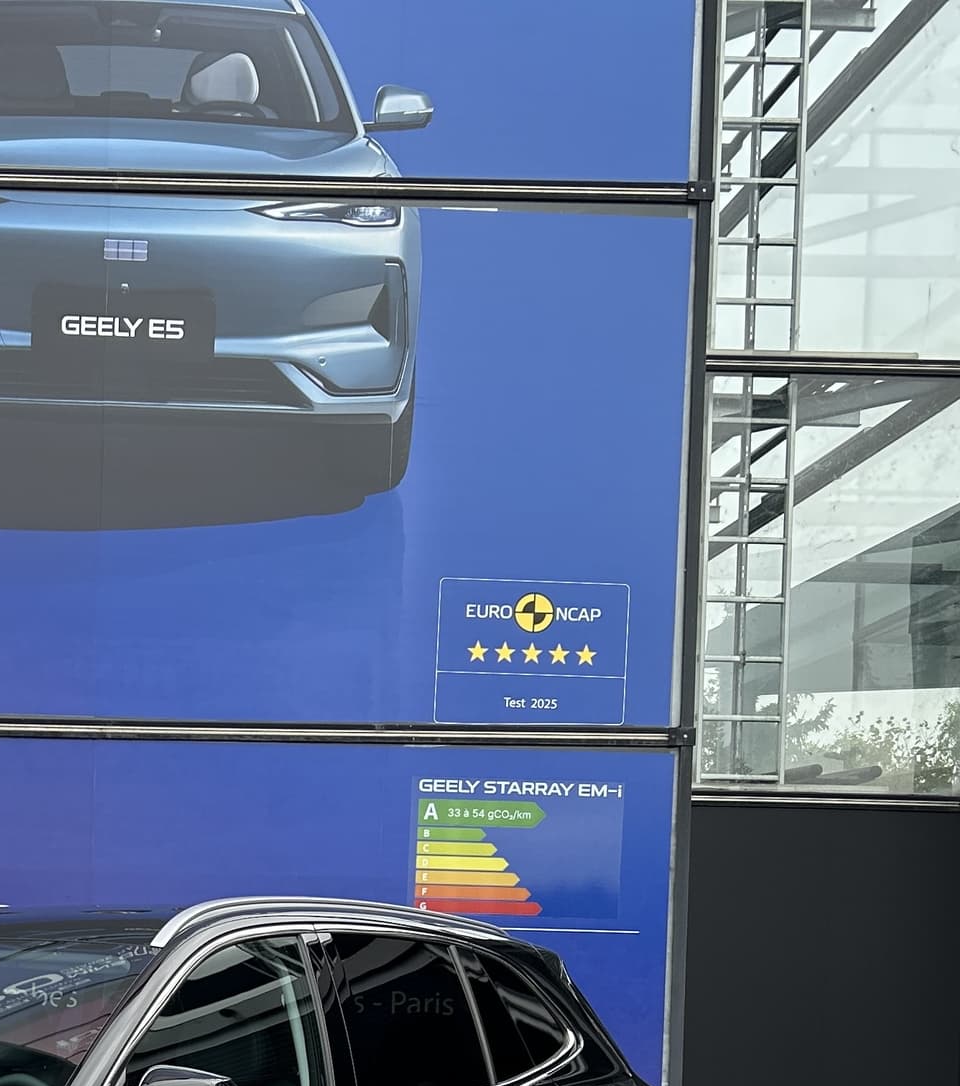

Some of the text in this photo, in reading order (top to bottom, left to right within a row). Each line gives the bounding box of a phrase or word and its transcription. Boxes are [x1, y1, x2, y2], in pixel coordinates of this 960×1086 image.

[61, 315, 185, 340] GEELY E5
[465, 603, 602, 622] EURO NCAP
[503, 697, 558, 709] Test 2025
[419, 778, 481, 794] GEELY
[483, 780, 575, 797] STARRAY
[423, 802, 439, 820] A
[447, 808, 461, 817] 33
[463, 808, 470, 818] à
[472, 808, 485, 818] 54
[423, 829, 430, 838] B
[422, 843, 430, 853] C
[422, 872, 429, 881] E
[421, 887, 429, 896] F
[419, 901, 427, 910] G
[391, 990, 455, 1016] Paris
